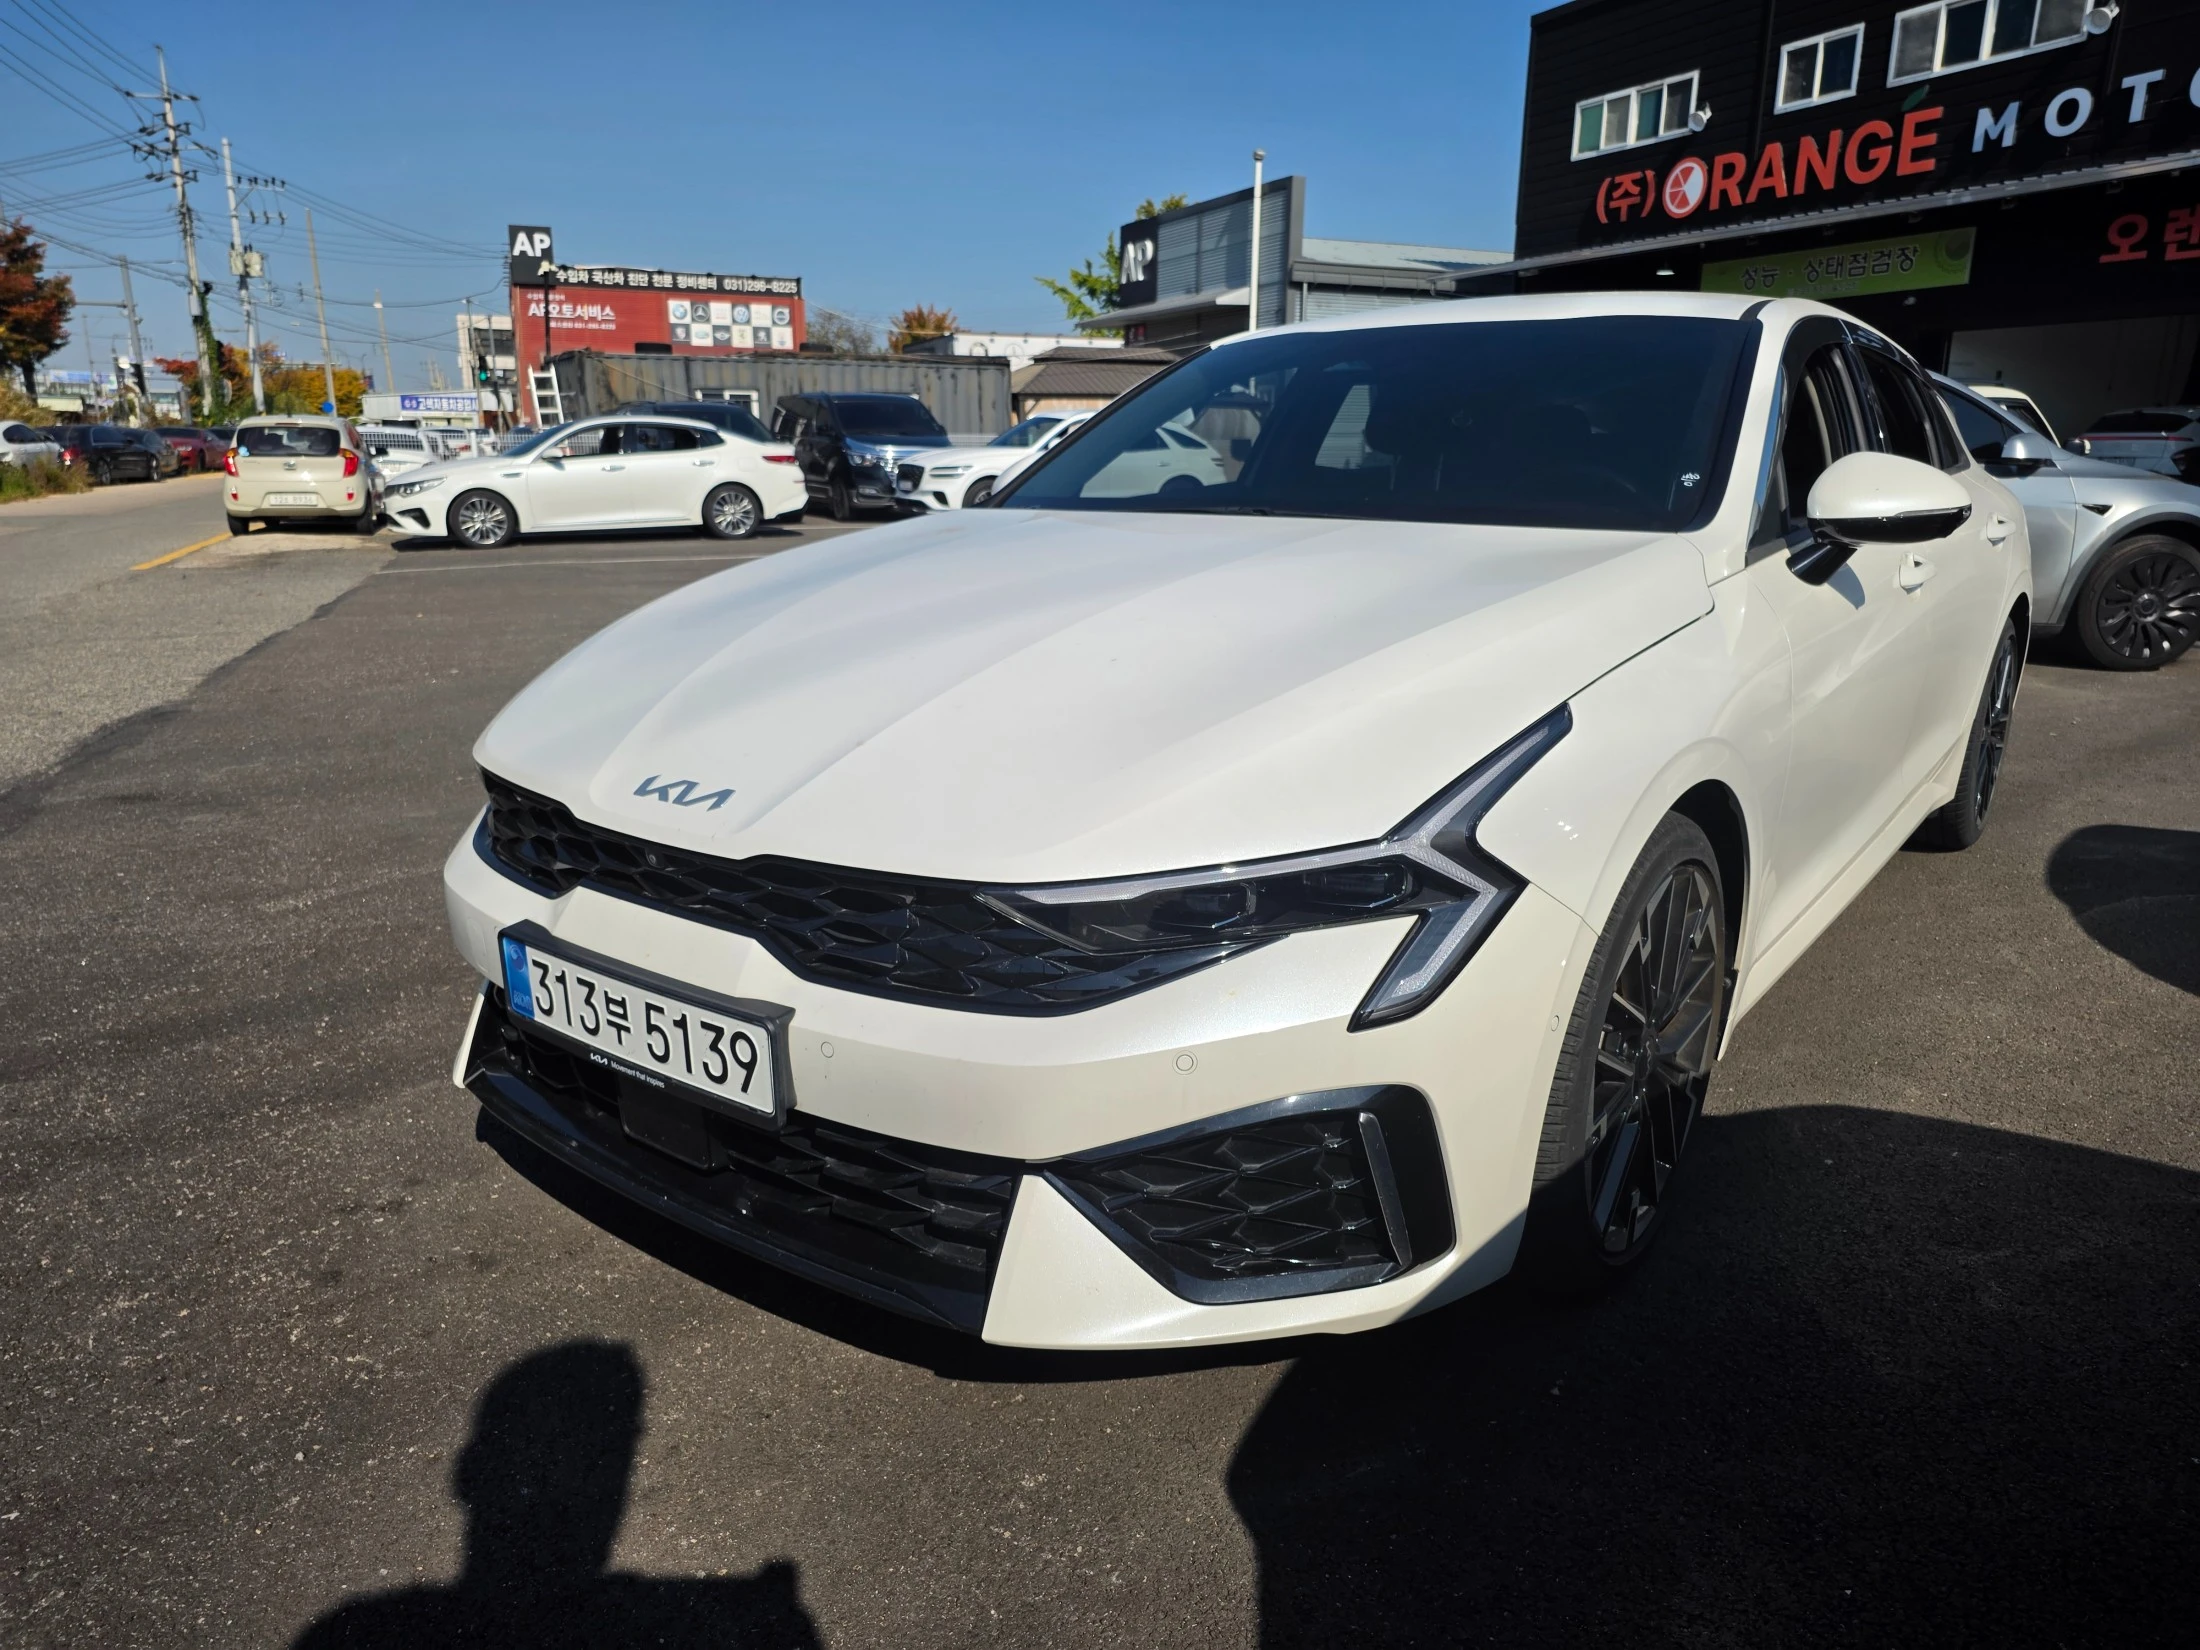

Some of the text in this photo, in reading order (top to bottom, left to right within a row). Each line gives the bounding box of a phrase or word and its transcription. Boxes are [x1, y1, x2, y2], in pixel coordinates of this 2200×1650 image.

[1972, 67, 2200, 153] MOT
[512, 231, 551, 257] AP
[1121, 239, 1153, 284] AP
[556, 269, 589, 284] 수입차
[592, 270, 625, 286] 국산차
[1741, 265, 1780, 290] 성능
[1803, 244, 1920, 283] 상태점검장
[531, 958, 758, 1094] 313부 5139
